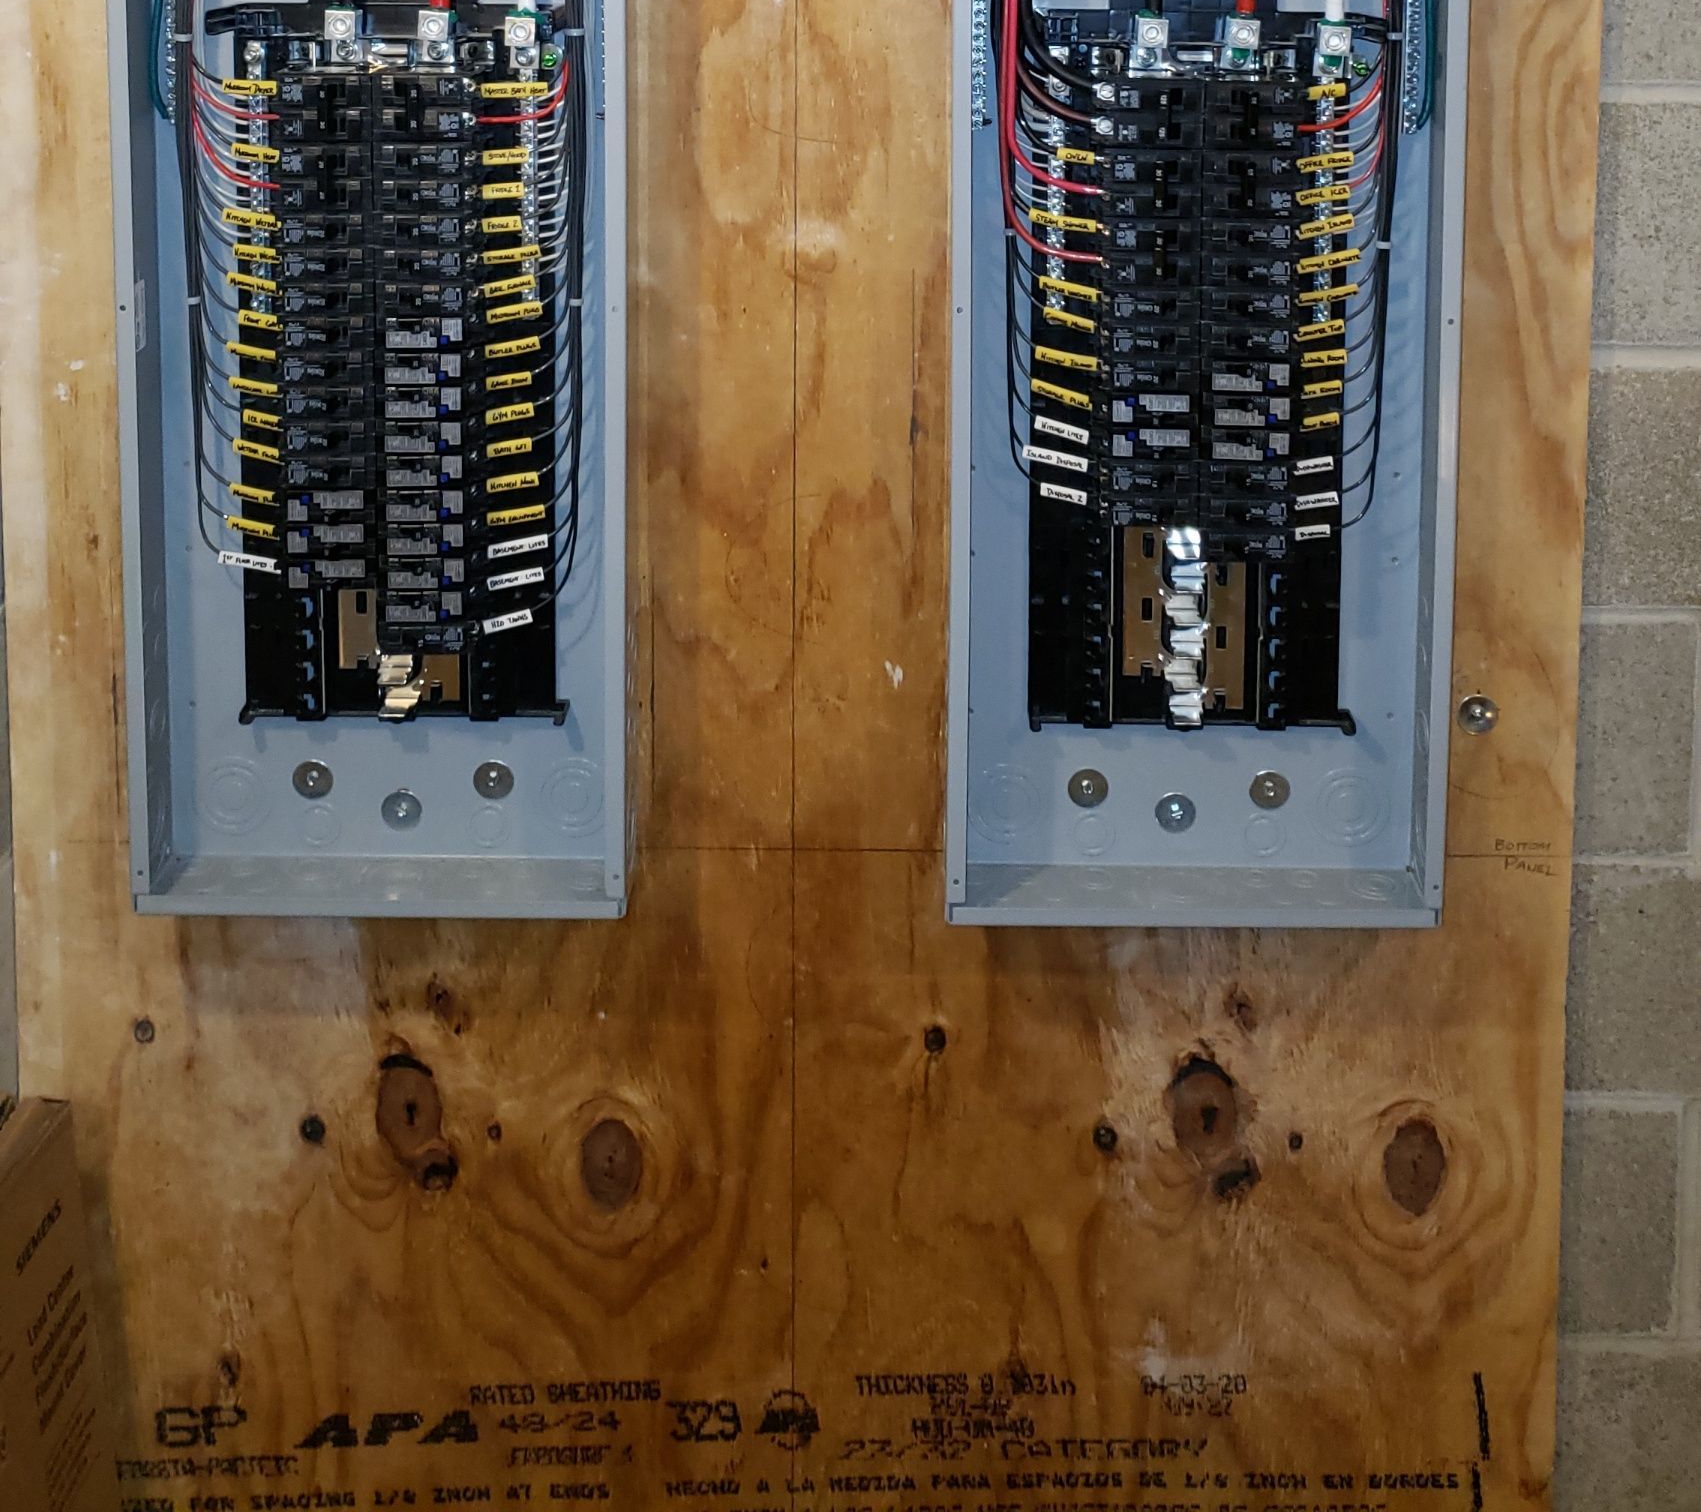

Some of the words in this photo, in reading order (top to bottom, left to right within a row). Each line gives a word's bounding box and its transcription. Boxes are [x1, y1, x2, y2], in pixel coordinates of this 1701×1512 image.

[1321, 88, 1337, 98] A/C
[1065, 152, 1088, 161] OVEN
[1035, 213, 1059, 226] STEAM
[1026, 449, 1053, 461] ISLAND
[1504, 855, 1561, 876] PANEL
[16, 1198, 62, 1277] SIEMENS
[469, 1384, 535, 1406] RATED
[546, 1379, 662, 1403] SHEATHING
[856, 1373, 970, 1396] THICKNESS
[155, 1405, 247, 1449] GP
[294, 1409, 479, 1449] APA
[664, 1399, 743, 1443] 329
[931, 1474, 991, 1490] PARA
[1322, 1473, 1355, 1489] EN
[190, 1496, 234, 1511] FOR
